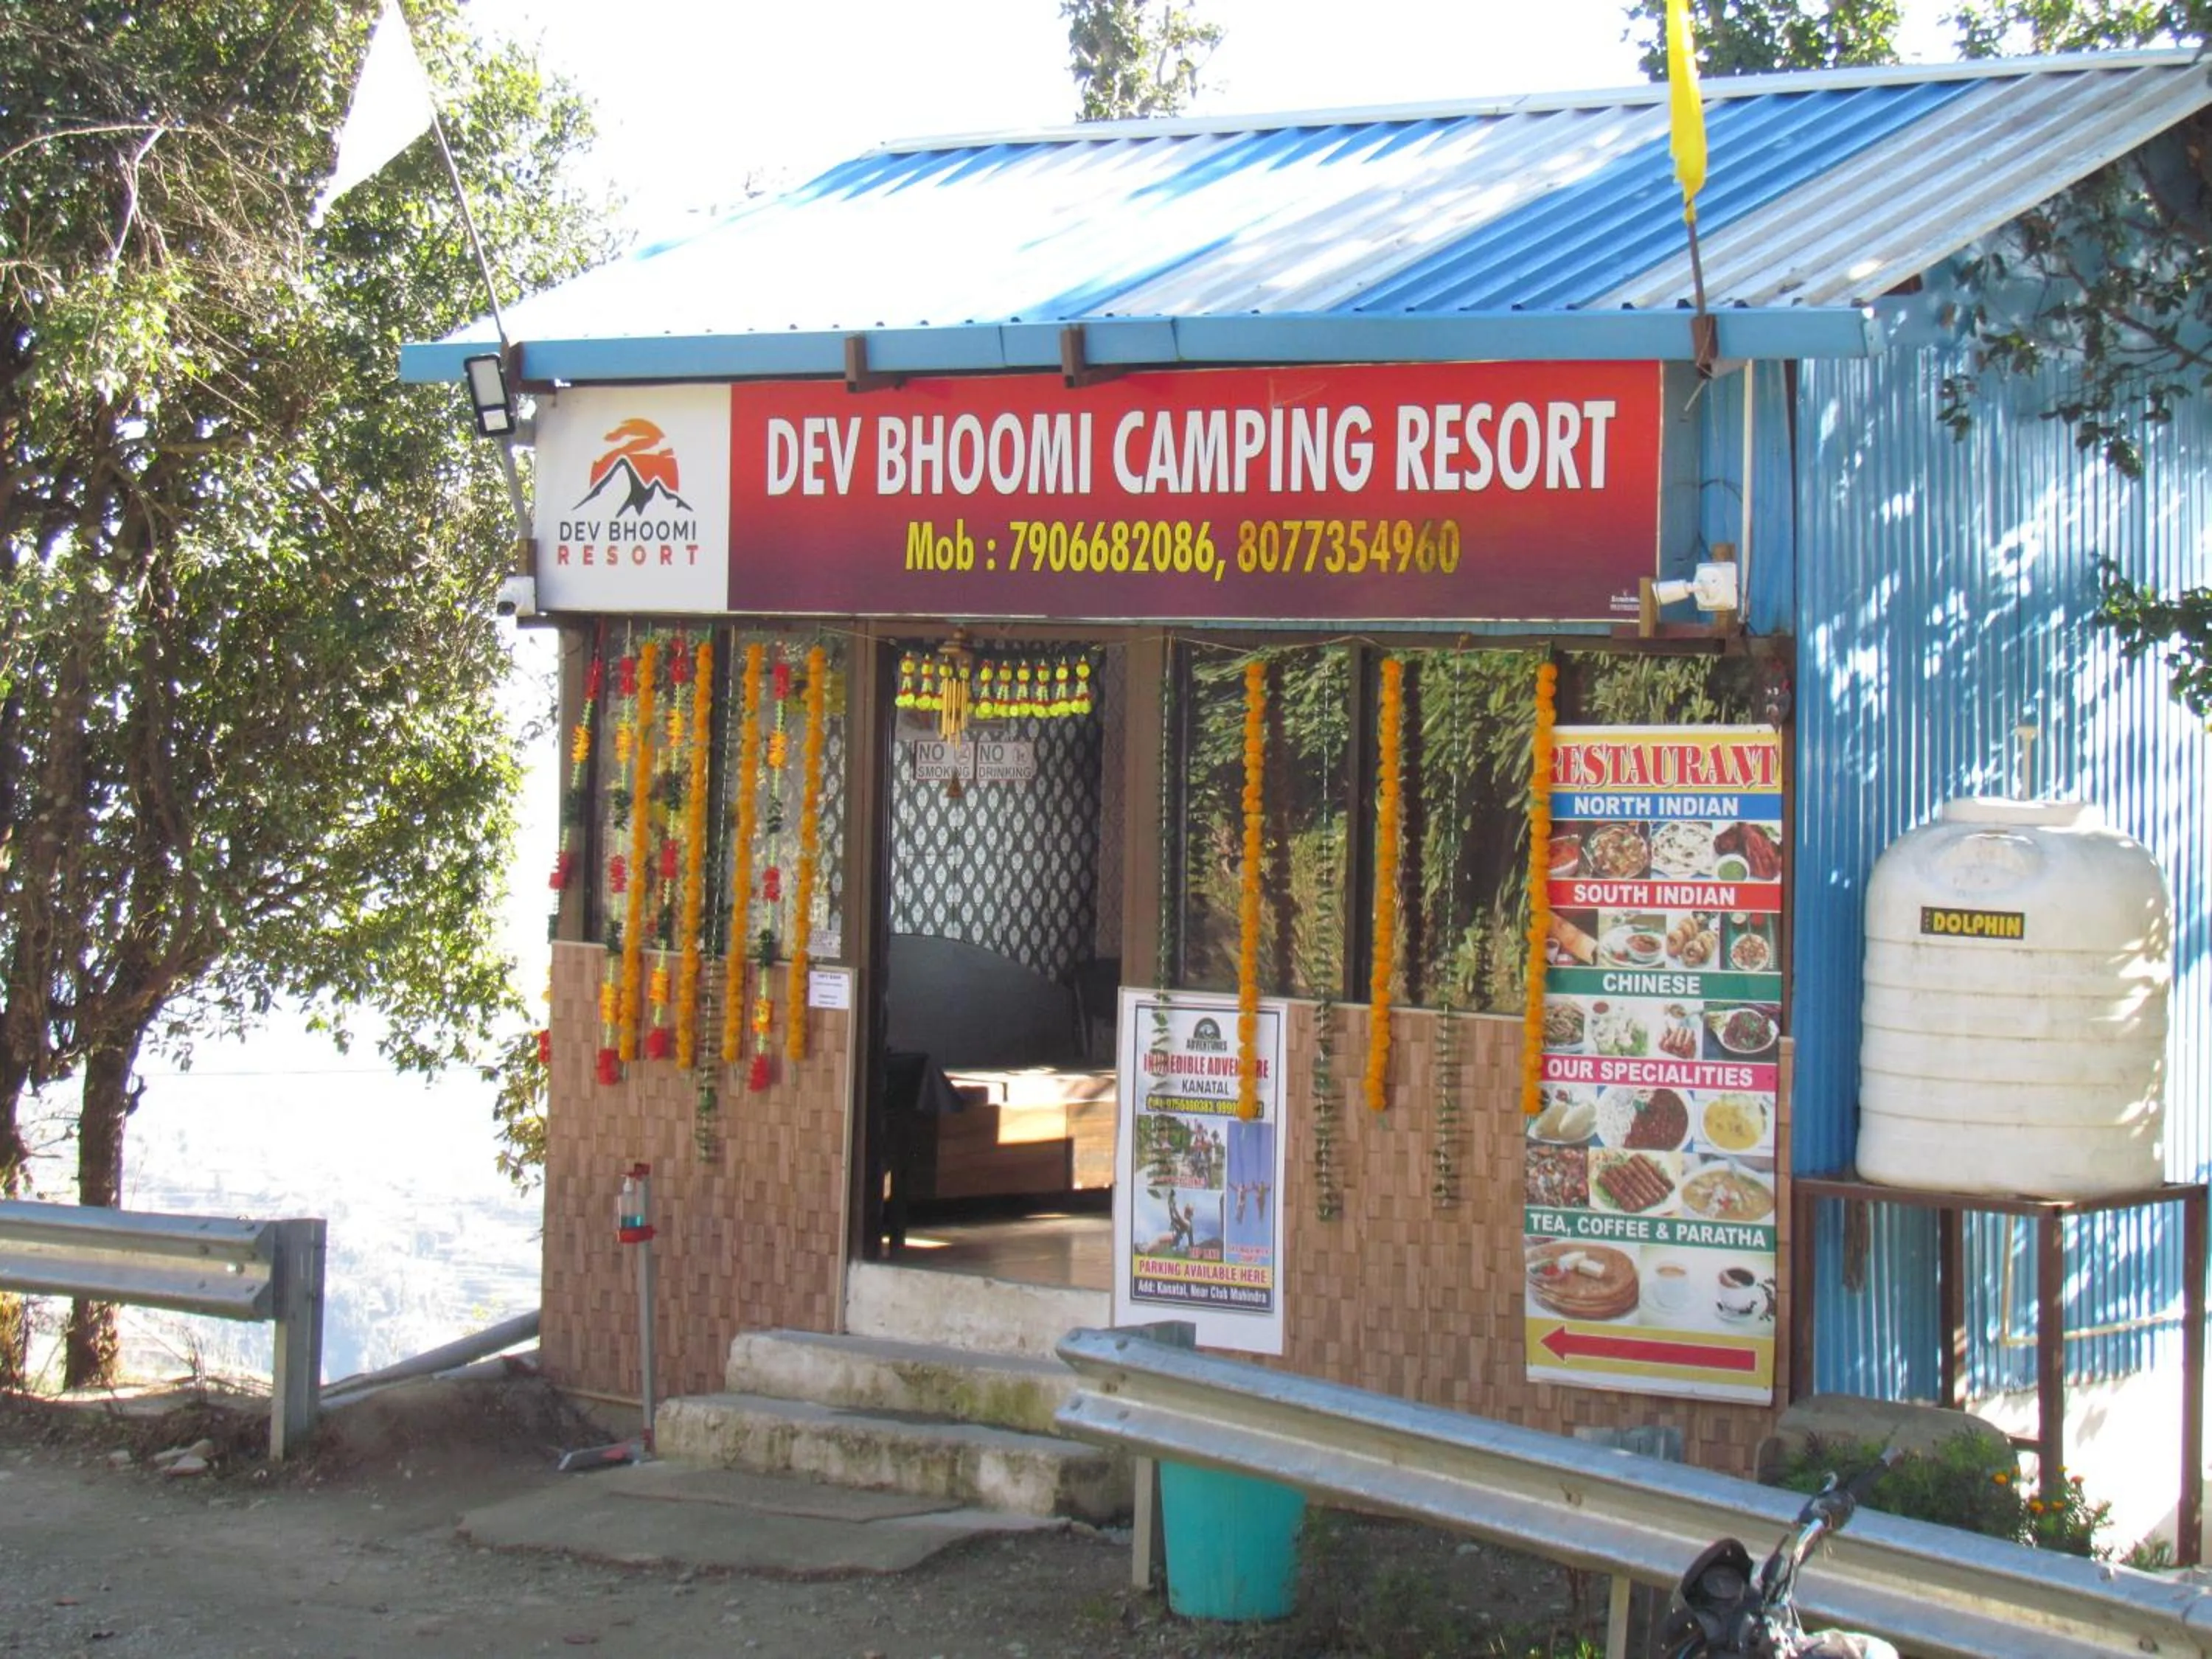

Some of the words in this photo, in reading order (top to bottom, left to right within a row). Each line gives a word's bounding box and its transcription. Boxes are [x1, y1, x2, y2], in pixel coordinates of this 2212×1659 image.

[768, 417, 861, 495] DEV
[877, 412, 1092, 495] BHOOMI
[1112, 405, 1374, 494] CAMPING
[1396, 400, 1616, 492] RESORT
[559, 521, 600, 541] DEV
[609, 521, 697, 541] BHOOMI
[557, 545, 699, 566] RESORT
[905, 519, 974, 571] Mob
[1009, 520, 1226, 581] 7906682086,
[1237, 520, 1461, 574] 8077354960
[919, 743, 945, 761] NO
[979, 744, 1004, 761] NO
[918, 765, 970, 778] SMOKING
[978, 766, 1032, 779] DRINKING
[1573, 796, 1652, 815] NORTH
[1659, 796, 1739, 816] INDIAN
[1573, 884, 1649, 904] SOUTH
[1656, 886, 1736, 905] INDIAN
[1933, 911, 2022, 937] DOLPHIN
[1602, 973, 1701, 995] CHINESE
[1548, 1059, 1594, 1079] OUR
[1600, 1062, 1753, 1088] SPECIALITIES
[1181, 1079, 1230, 1096] KANATAL
[1530, 1213, 1571, 1237] TEA,
[1577, 1217, 1649, 1239] COFFEE
[1655, 1222, 1669, 1240] &
[1676, 1224, 1766, 1248] PARATHA
[1139, 1259, 1180, 1276] PARKING
[1184, 1263, 1237, 1281] AVAILABLE
[1240, 1268, 1267, 1284] HERE
